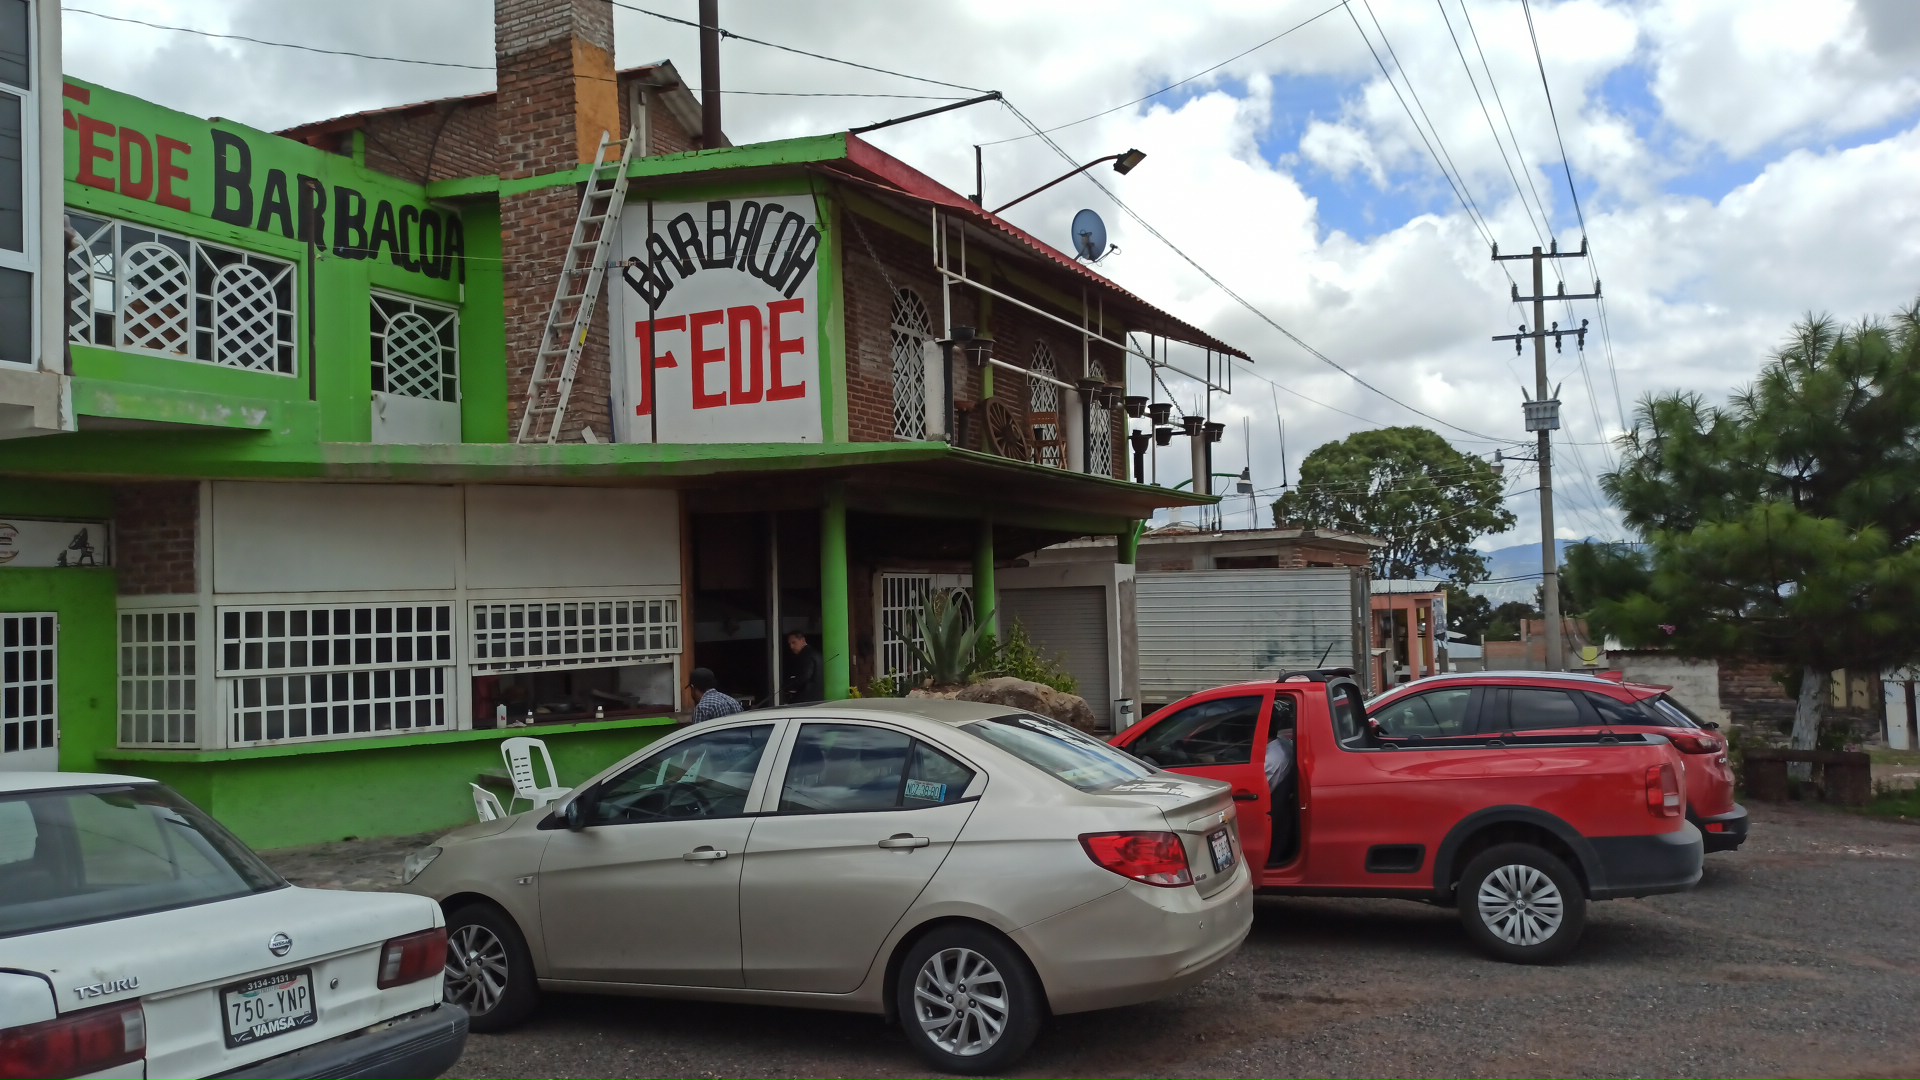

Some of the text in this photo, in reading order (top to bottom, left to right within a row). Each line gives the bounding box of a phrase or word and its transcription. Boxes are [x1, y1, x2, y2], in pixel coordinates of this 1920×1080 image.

[211, 128, 466, 285] BARBACOA
[622, 200, 822, 311] BARBACOA
[635, 297, 806, 416] FEDE
[74, 976, 140, 1000] TSURU
[247, 973, 290, 991] 3134-3131
[232, 986, 307, 1026] 750-YNP
[252, 1016, 297, 1038] VAMSA
